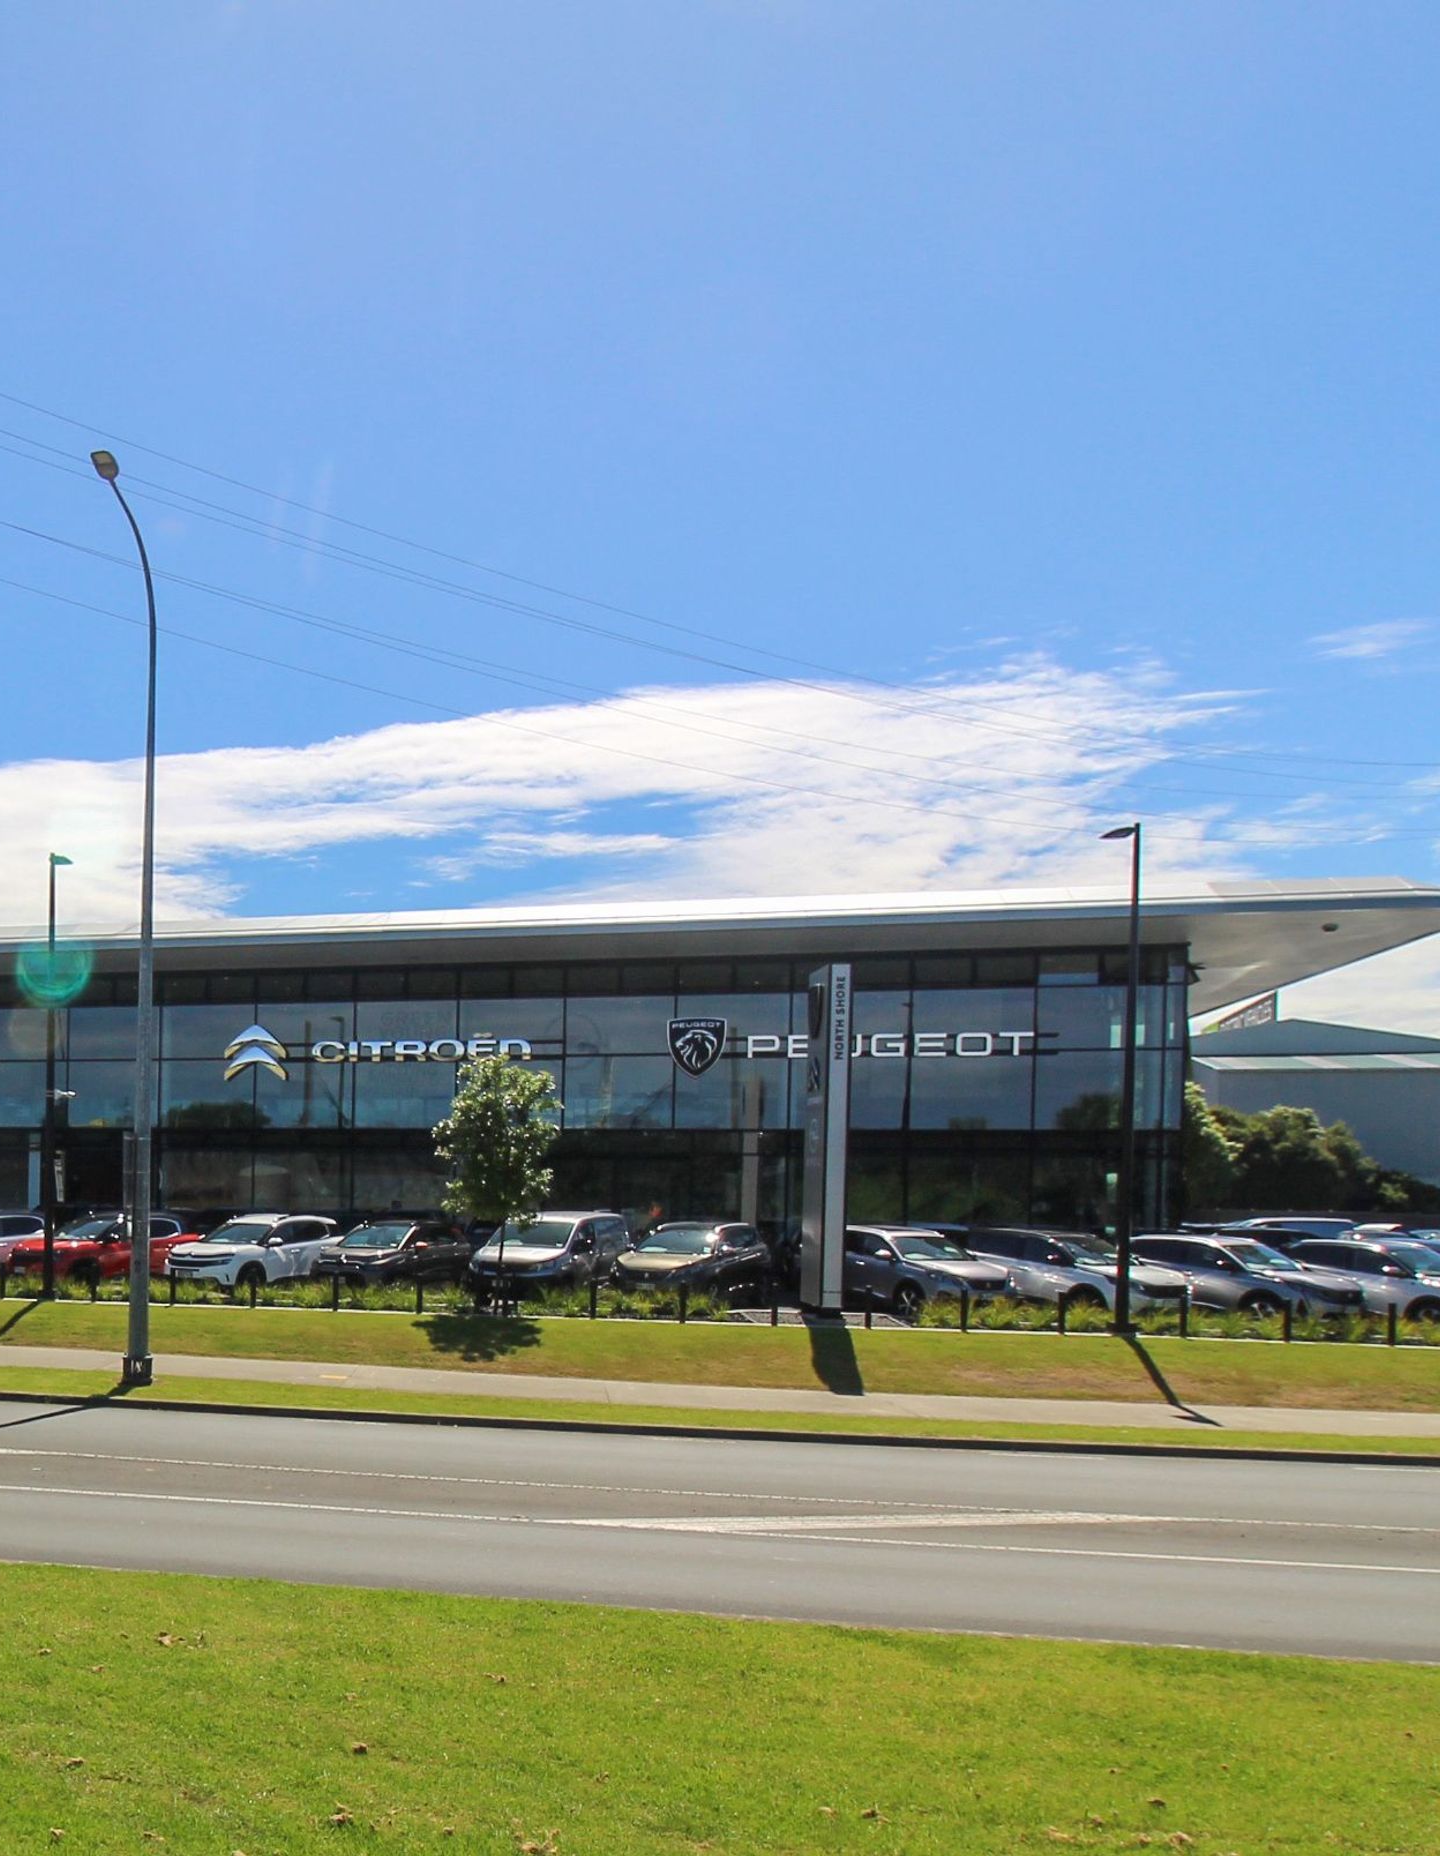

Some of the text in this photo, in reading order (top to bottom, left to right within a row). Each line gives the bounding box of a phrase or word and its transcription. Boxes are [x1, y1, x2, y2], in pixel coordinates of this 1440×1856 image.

[671, 1021, 721, 1029] PEUGEOT
[834, 975, 847, 1060] NORTH SHORE
[311, 1032, 532, 1063] CITROËN
